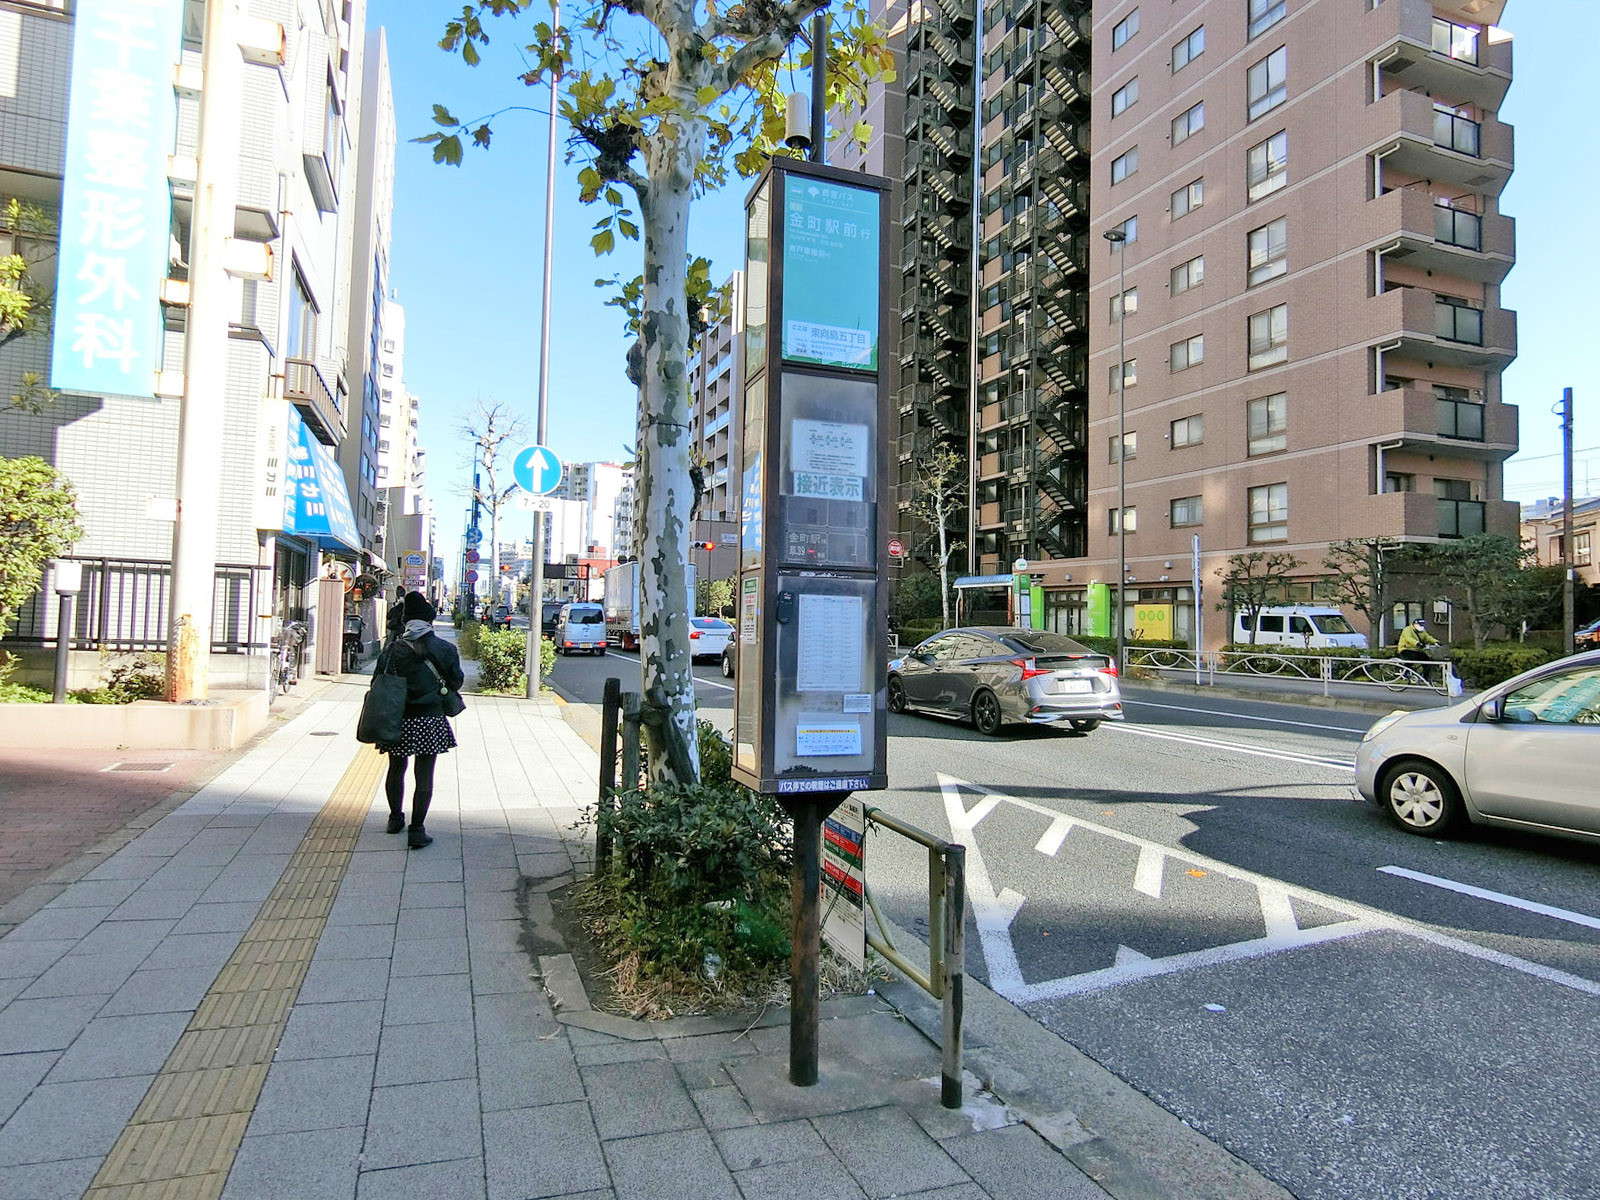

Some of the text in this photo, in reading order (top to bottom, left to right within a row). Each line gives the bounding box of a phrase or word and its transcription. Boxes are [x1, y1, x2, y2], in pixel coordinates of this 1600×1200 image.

[72, 12, 157, 373] 千葉整形外科
[789, 212, 872, 240] 金町駅前行
[811, 327, 866, 344] 東向島五丁目
[265, 457, 278, 497] ミカミ
[796, 473, 860, 498] 接近表示
